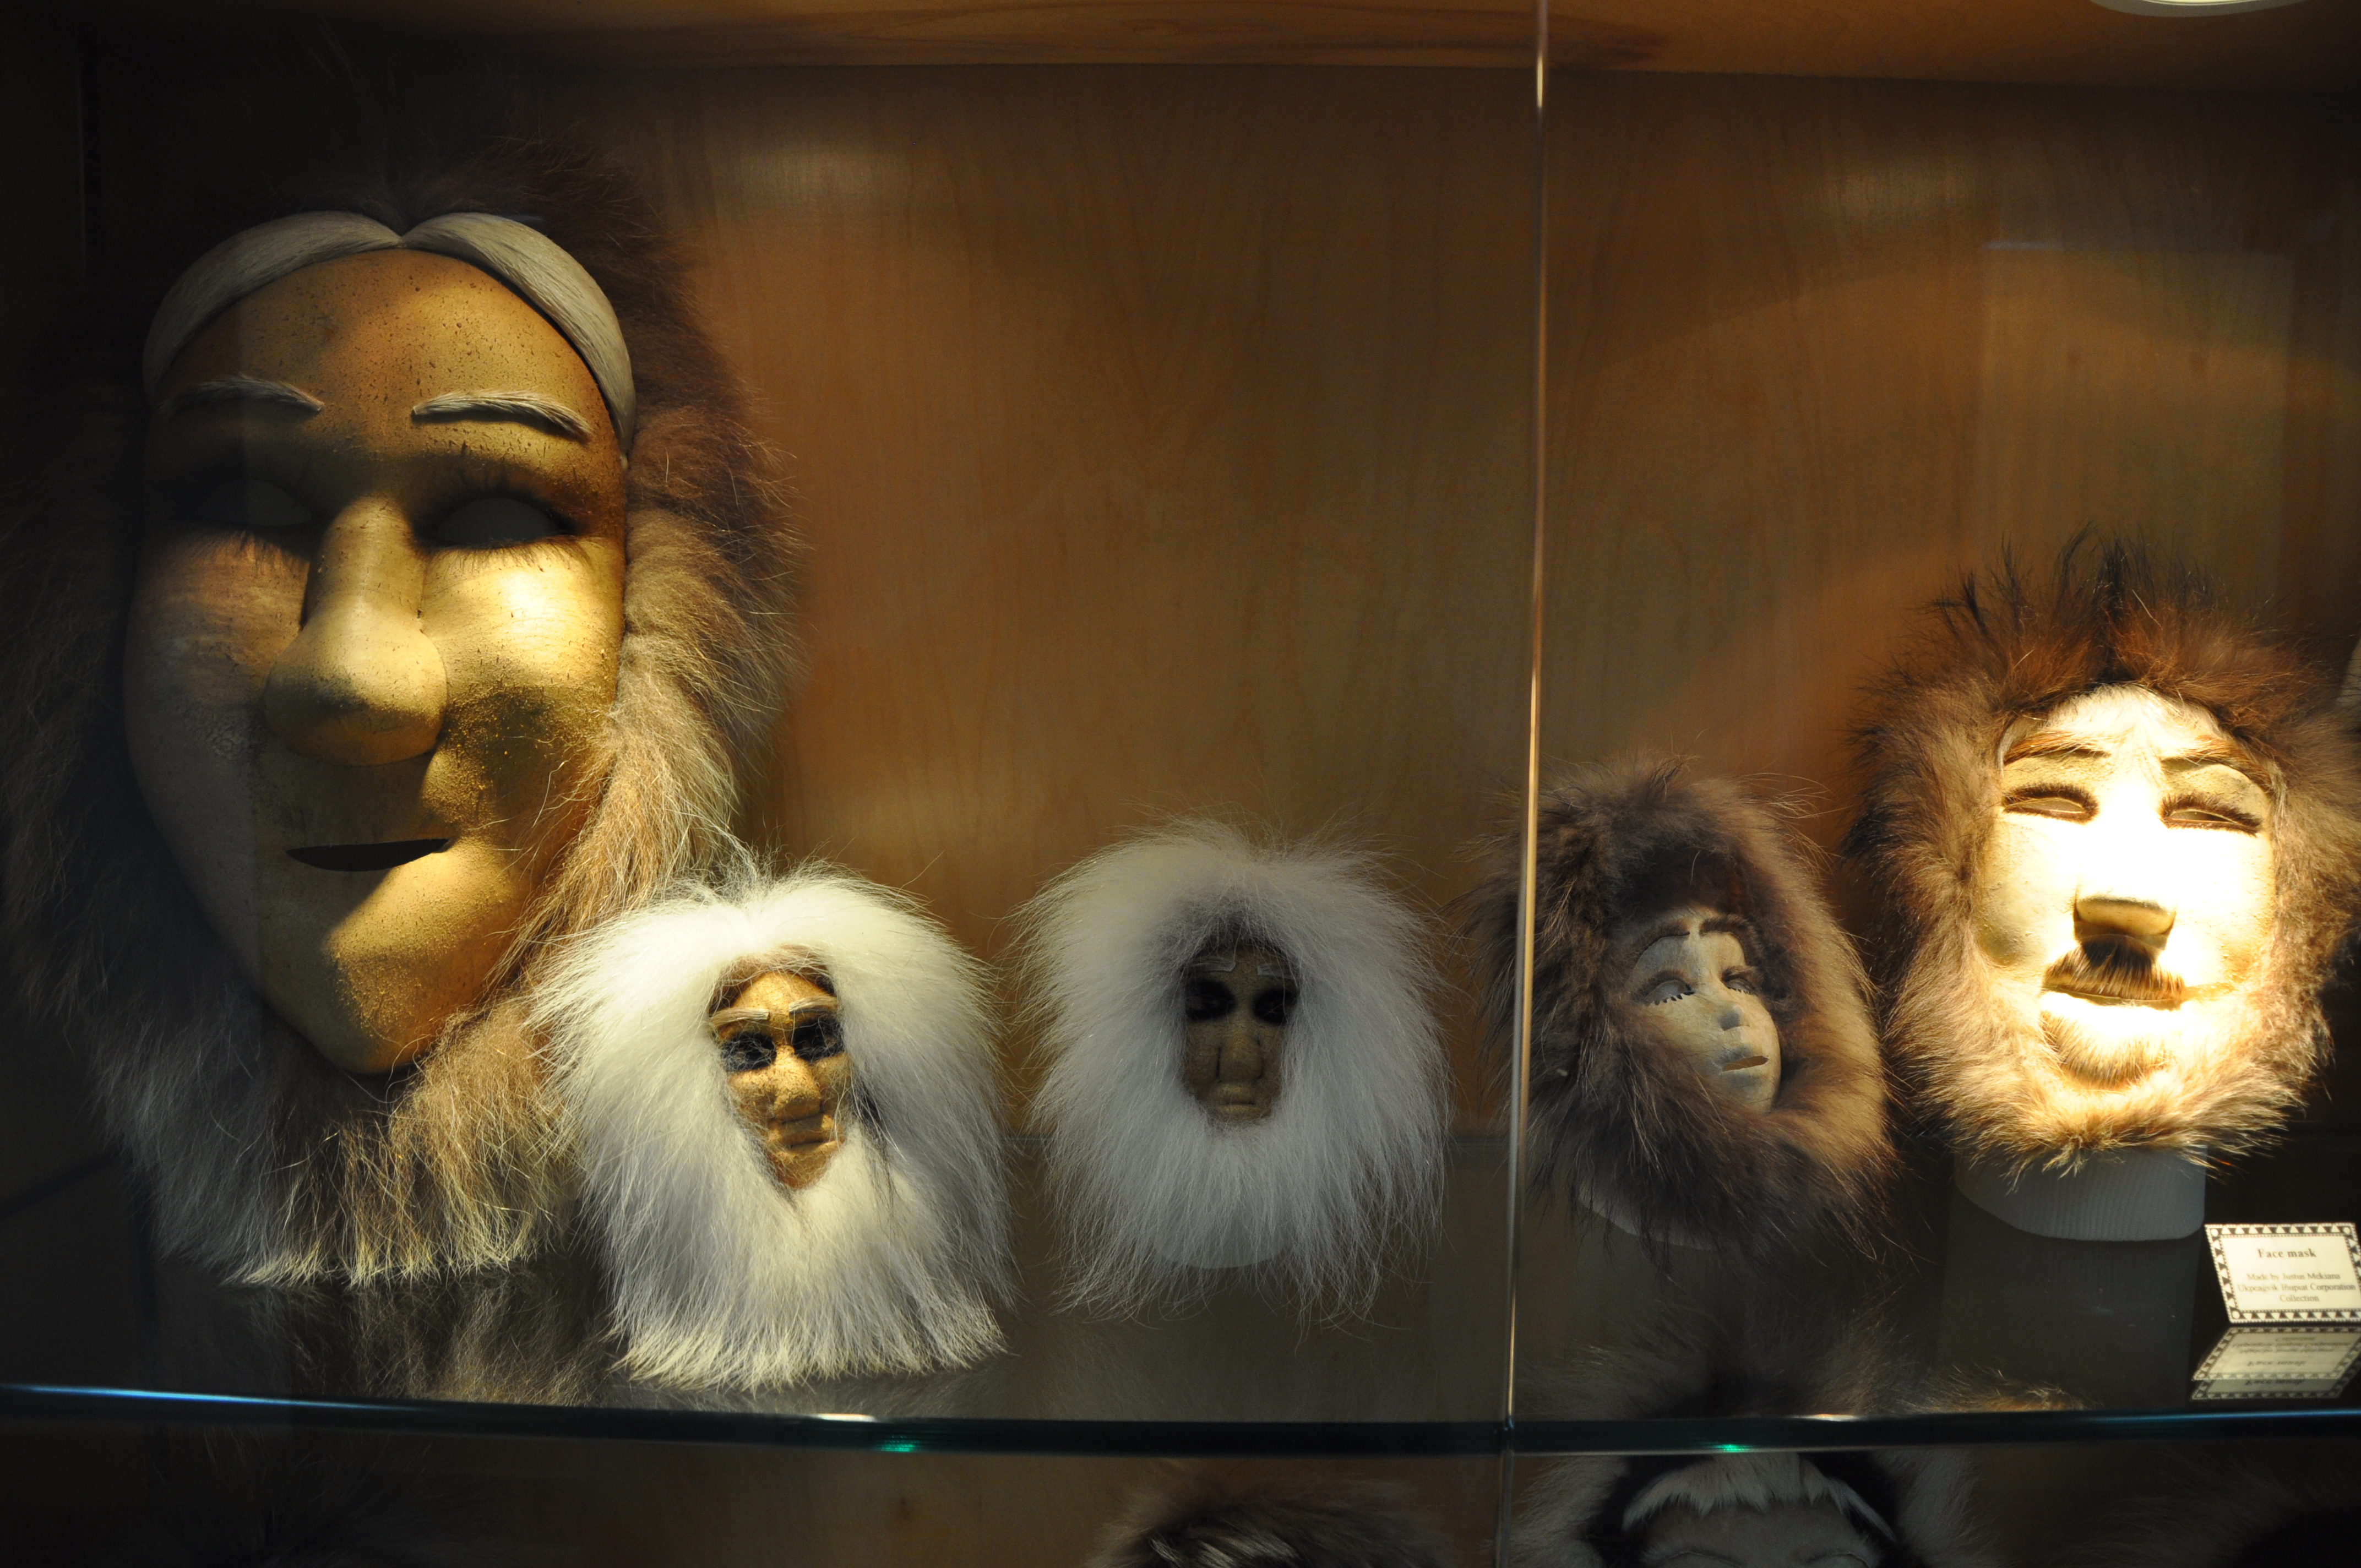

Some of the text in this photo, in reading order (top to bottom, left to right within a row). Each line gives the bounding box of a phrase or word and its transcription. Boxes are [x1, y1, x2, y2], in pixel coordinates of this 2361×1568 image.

[2257, 1248, 2317, 1258] Face mask
[2270, 1273, 2280, 1282] by
[2310, 1283, 2356, 1292] Corporation
